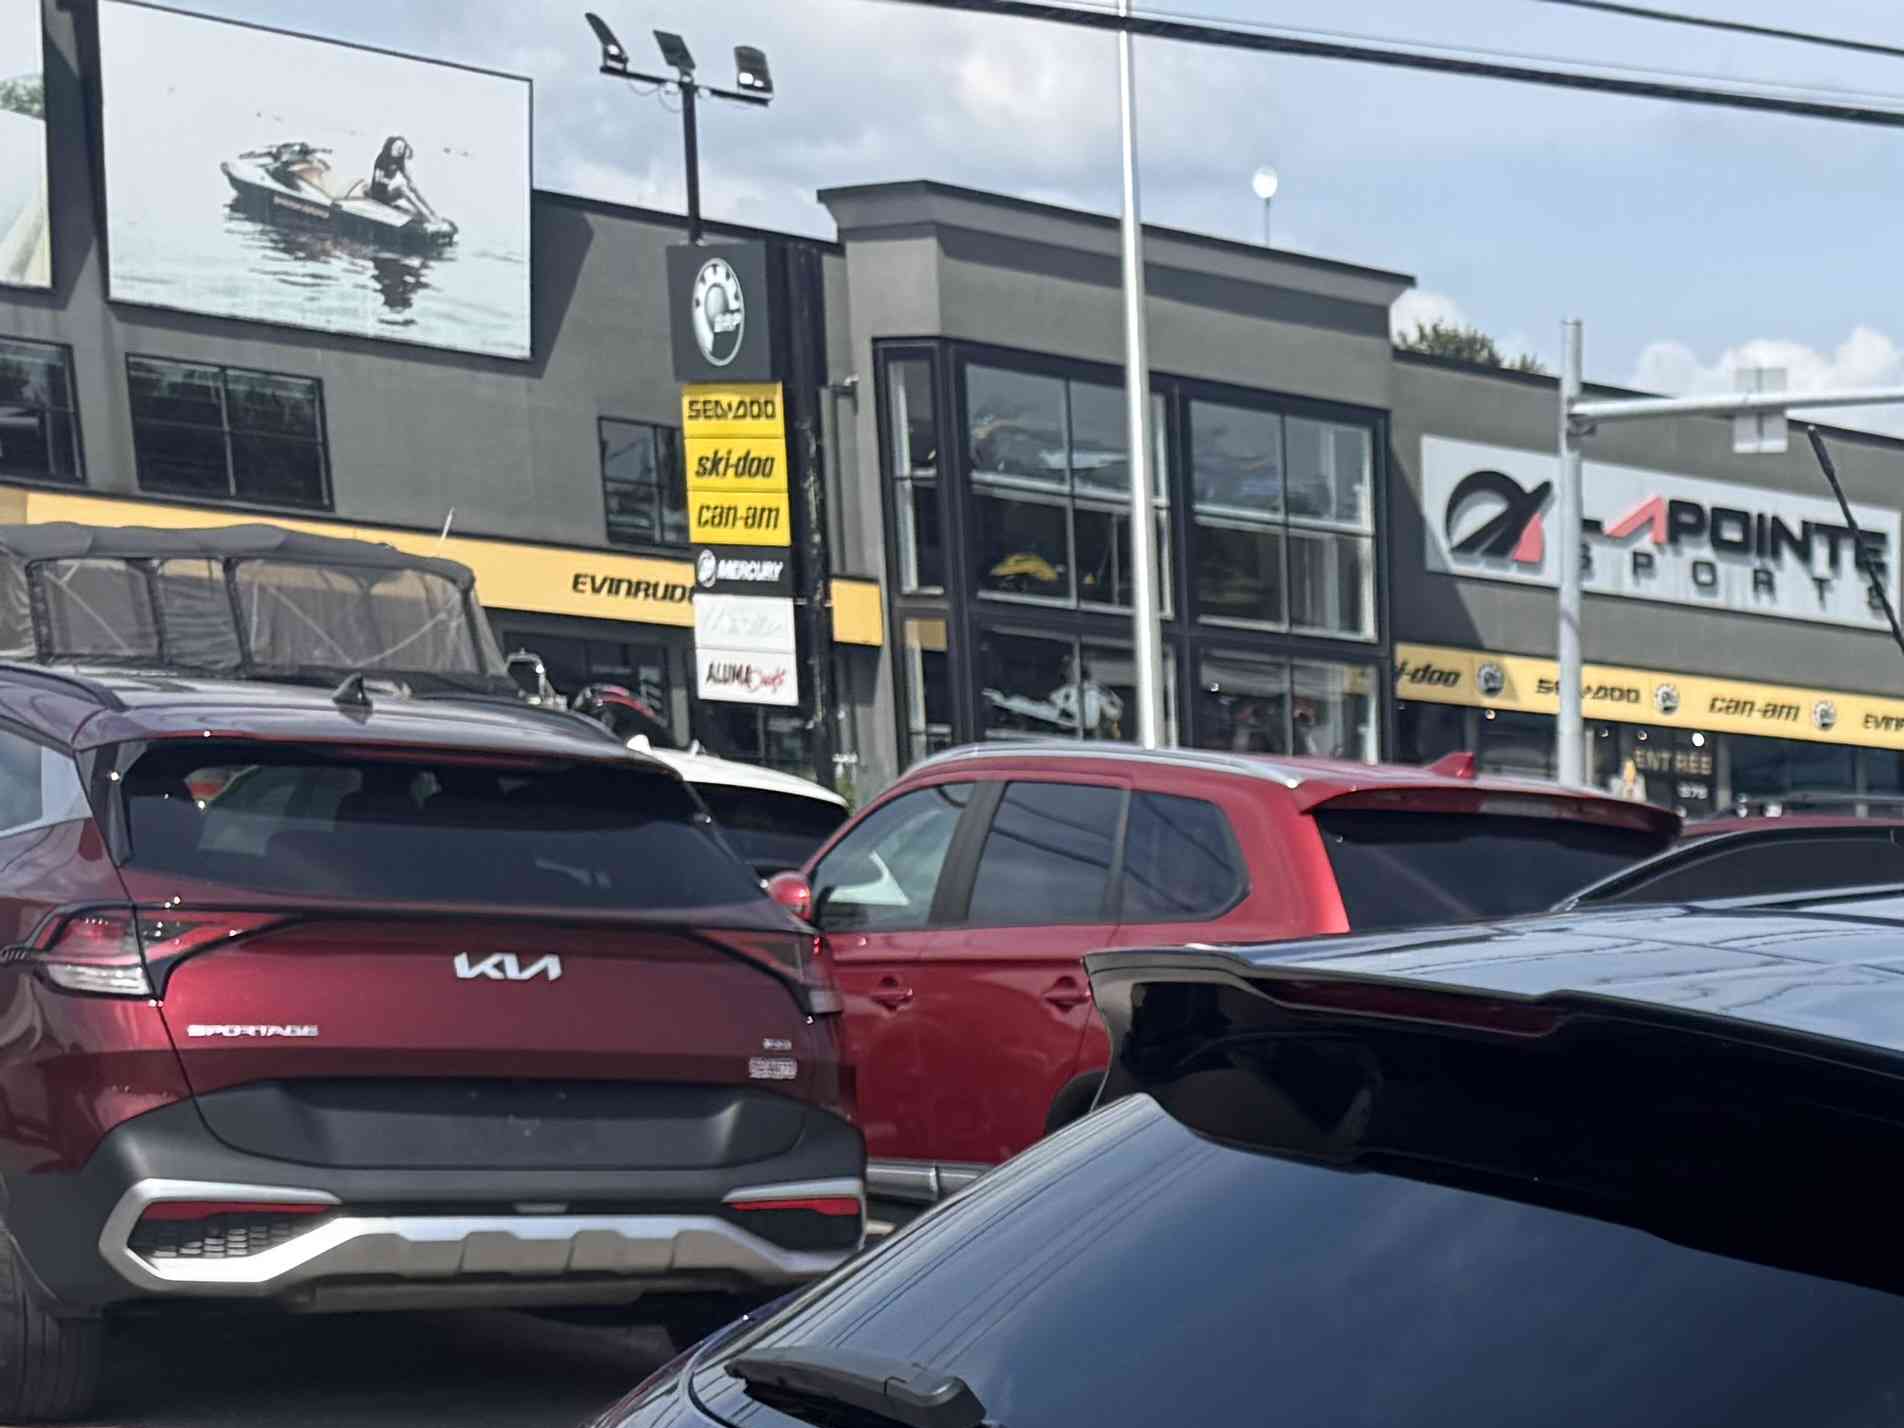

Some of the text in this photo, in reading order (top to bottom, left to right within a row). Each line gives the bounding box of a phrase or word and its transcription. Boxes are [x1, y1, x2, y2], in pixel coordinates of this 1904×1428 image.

[695, 449, 776, 478] ski-doo
[697, 503, 780, 530] can-am
[717, 559, 783, 581] MERCURY
[1709, 695, 1800, 722] can-am
[453, 952, 562, 981] KIA
[187, 1024, 319, 1037] SPORTAGE
